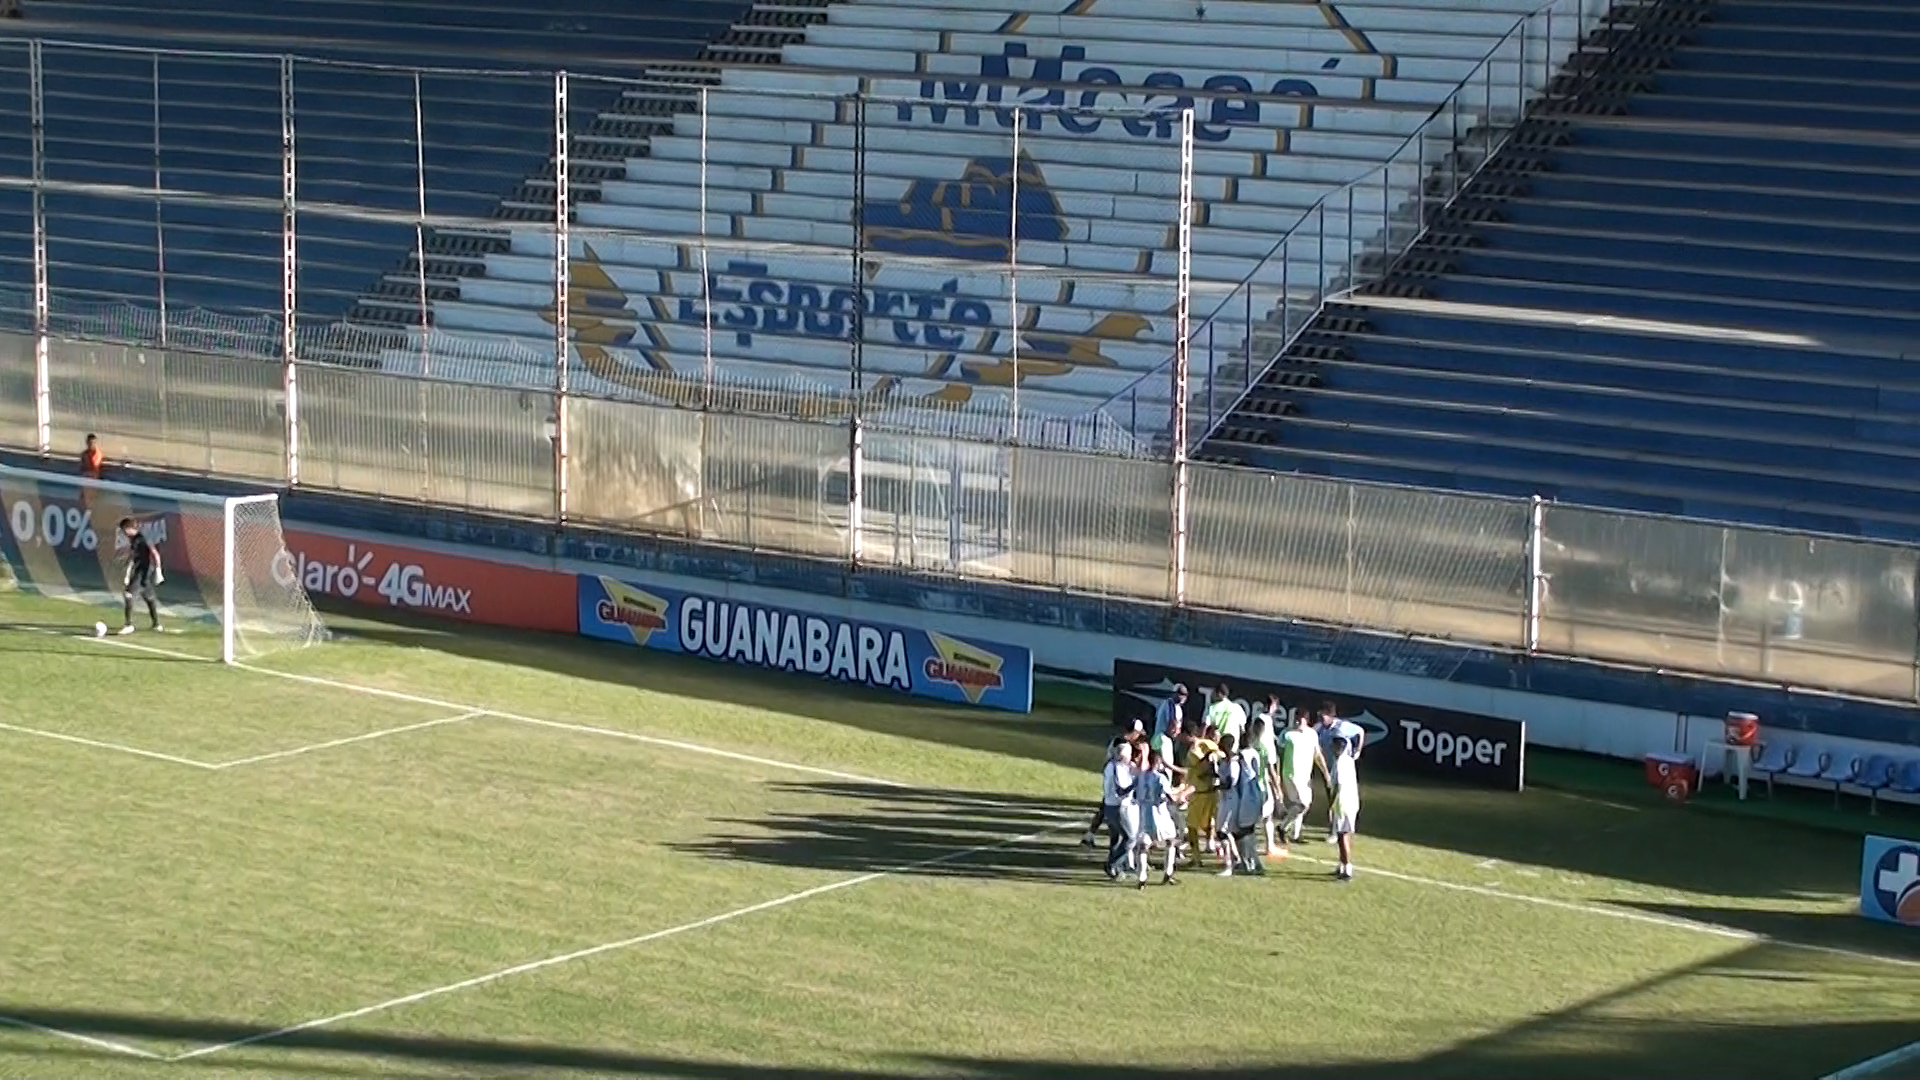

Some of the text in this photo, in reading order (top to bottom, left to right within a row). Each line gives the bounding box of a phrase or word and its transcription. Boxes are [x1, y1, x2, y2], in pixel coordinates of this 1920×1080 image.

[12, 501, 98, 550] 0,0%
[681, 597, 911, 689] GUANABARA
[1400, 719, 1507, 767] Topper
